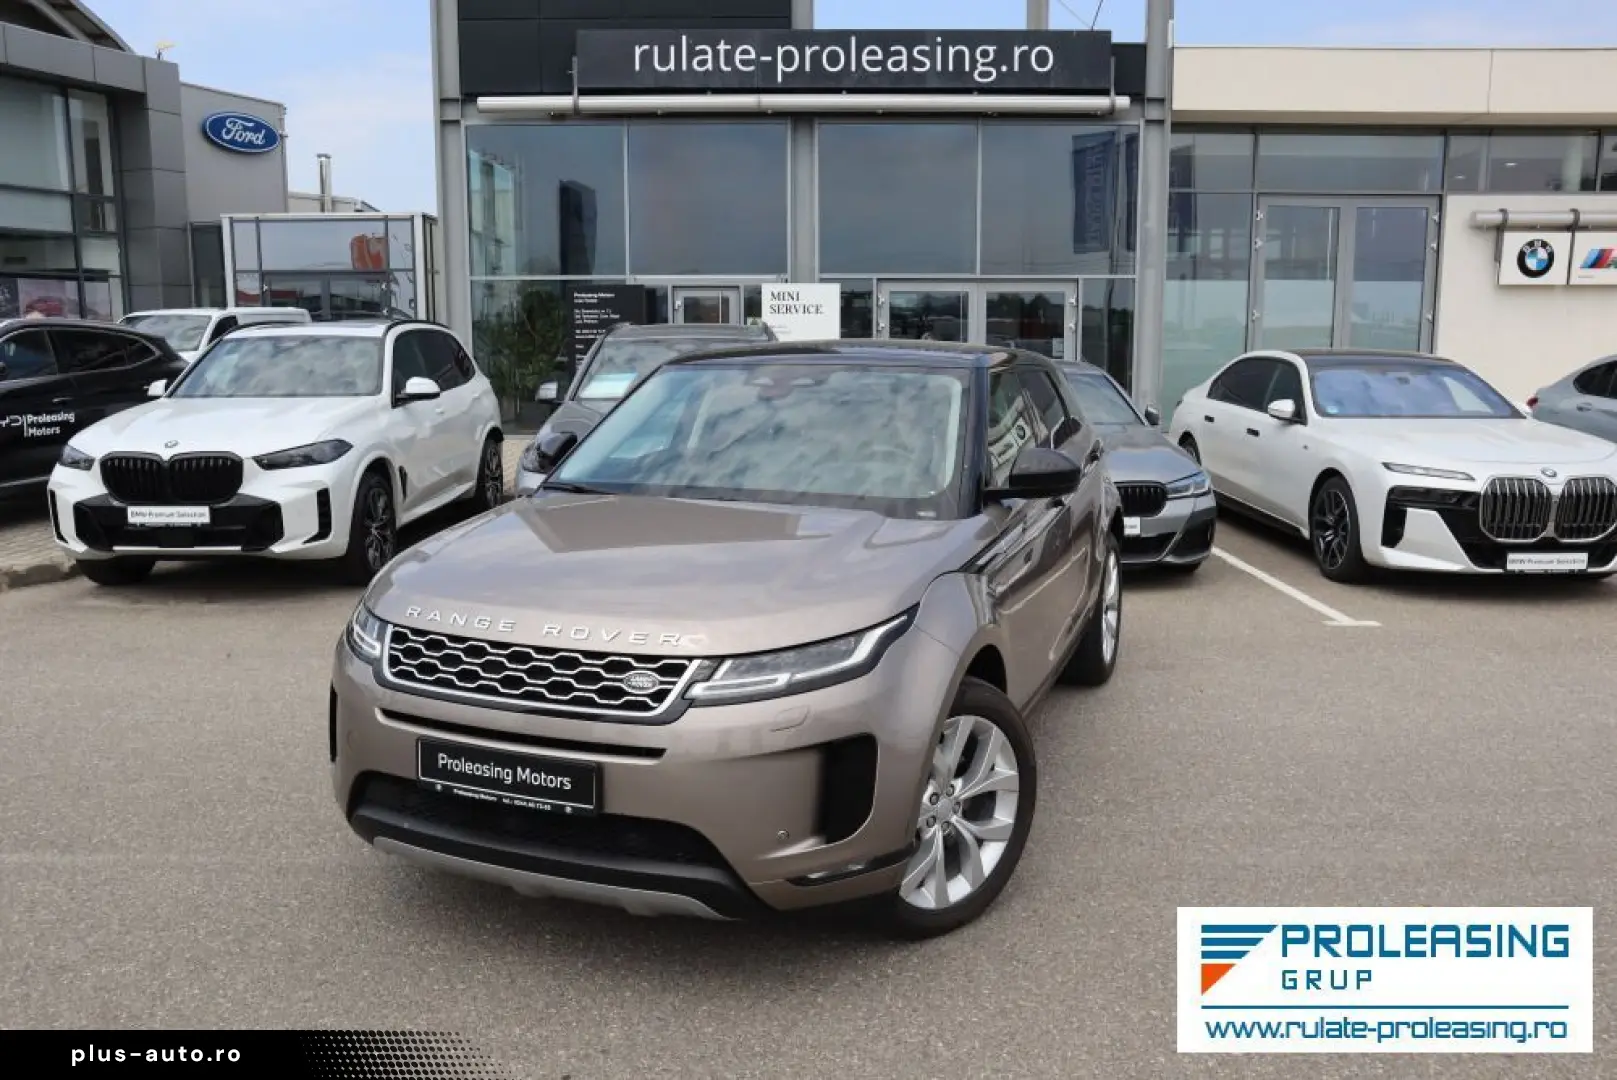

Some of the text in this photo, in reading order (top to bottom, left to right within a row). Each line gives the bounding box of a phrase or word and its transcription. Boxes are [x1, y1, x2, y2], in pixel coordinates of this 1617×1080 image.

[633, 34, 1054, 83] rulate-proleasing.ro
[221, 117, 266, 145] Ford
[770, 290, 800, 302] MINI
[769, 303, 825, 315] SERVICE
[27, 411, 75, 424] Proleasing
[28, 426, 61, 437] Motors
[404, 605, 682, 647] RANGE ROVER
[437, 752, 572, 790] Proleasing Motors
